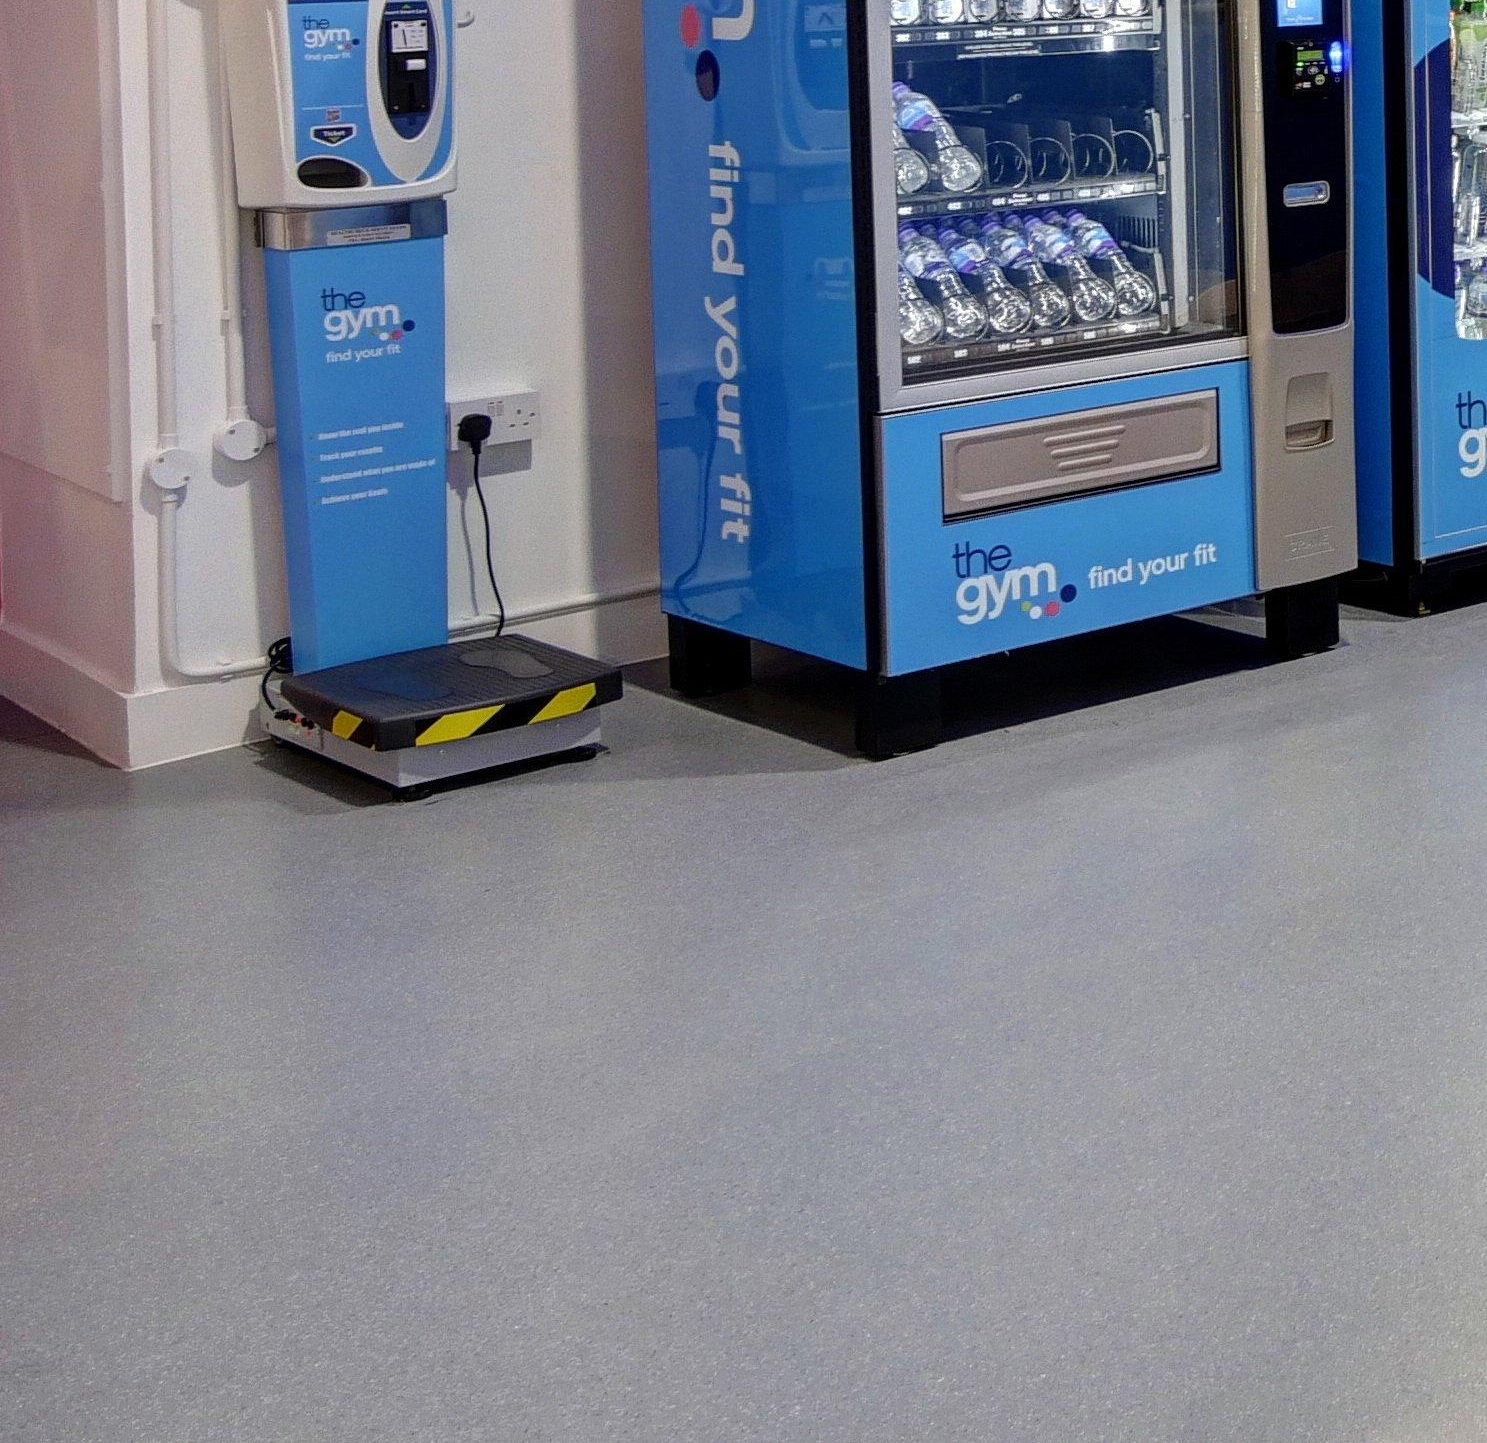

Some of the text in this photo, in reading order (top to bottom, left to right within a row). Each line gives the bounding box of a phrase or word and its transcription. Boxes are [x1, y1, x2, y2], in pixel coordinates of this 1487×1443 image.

[302, 15, 330, 30] the
[304, 27, 351, 48] gym
[321, 287, 367, 311] the
[324, 304, 401, 342] gym
[325, 342, 401, 364] find your fit
[702, 139, 756, 545] find your fit
[952, 541, 1012, 579] the
[956, 542, 1218, 625] gym find your fit
